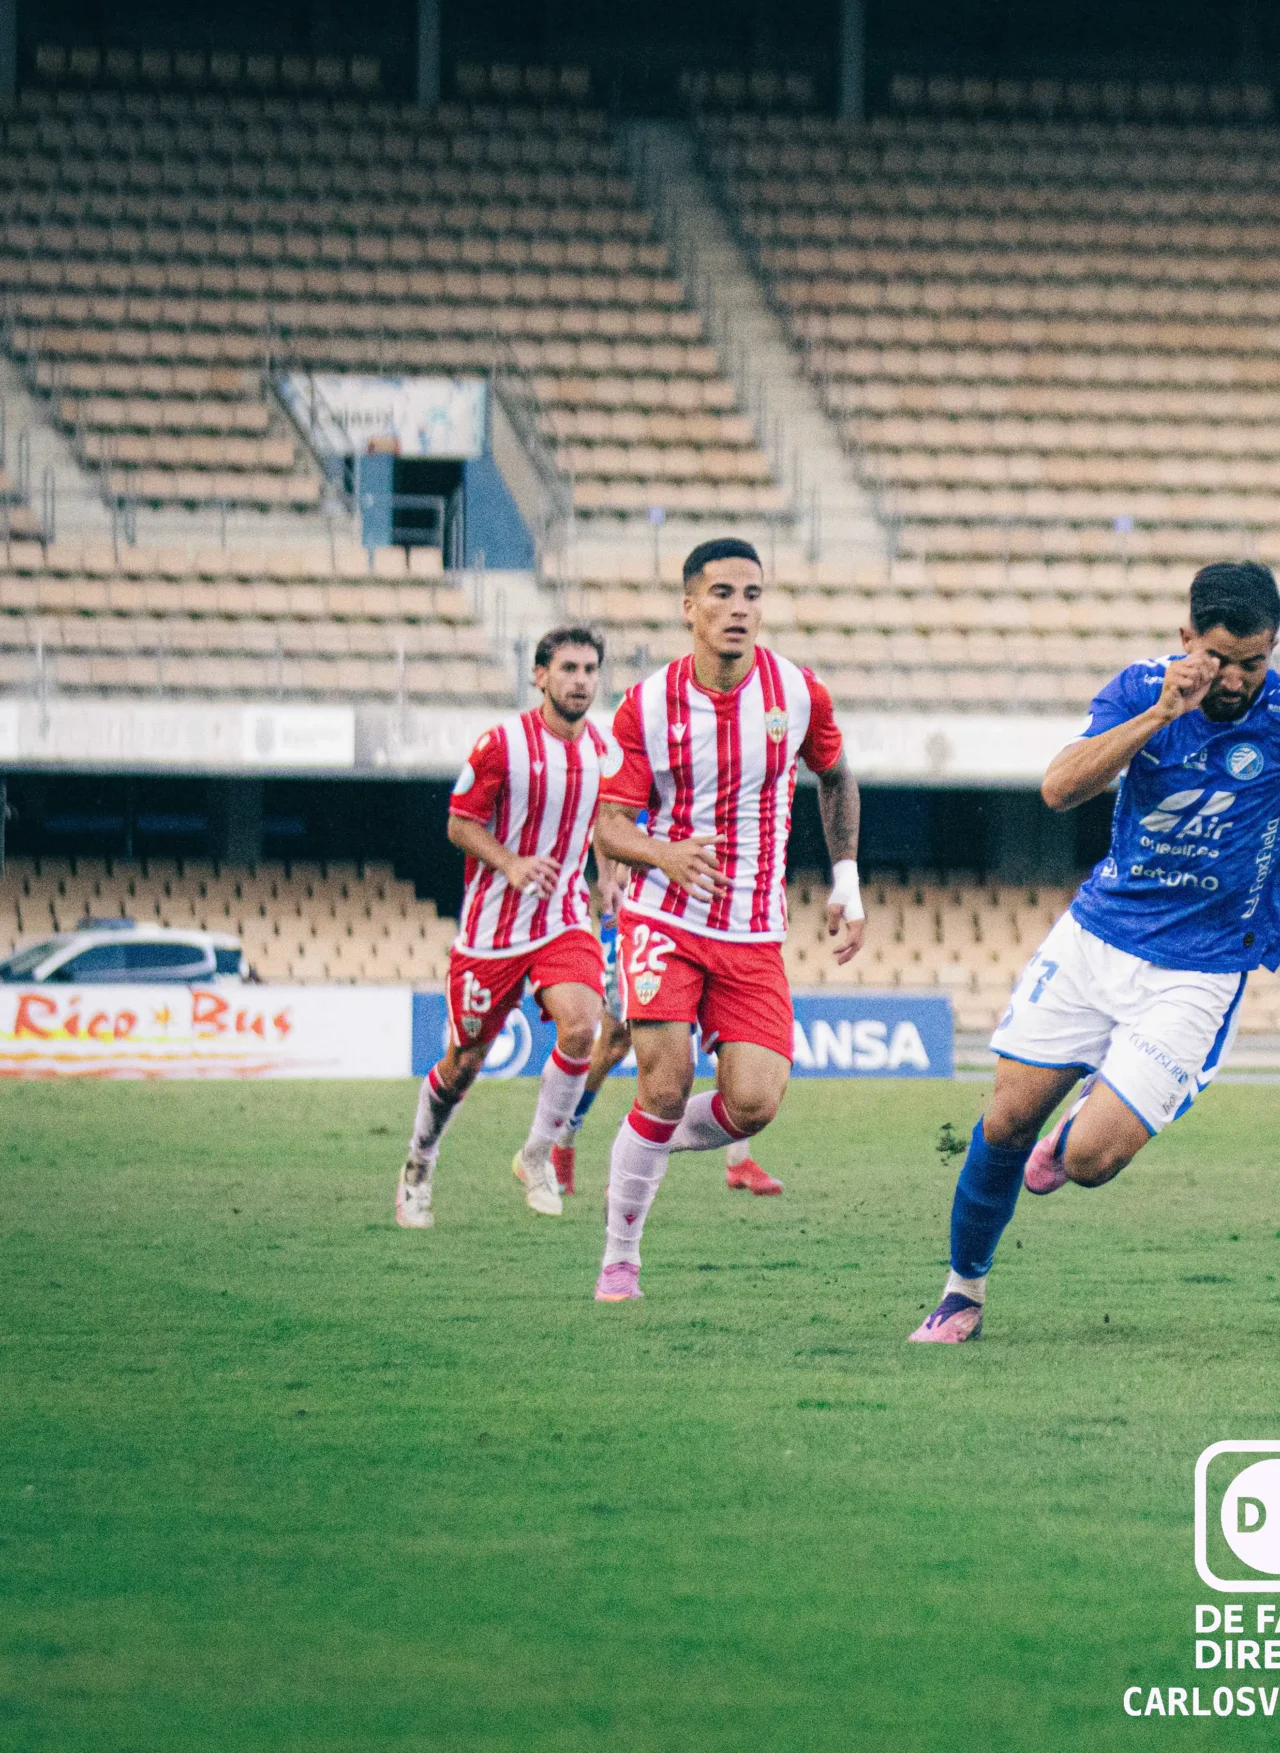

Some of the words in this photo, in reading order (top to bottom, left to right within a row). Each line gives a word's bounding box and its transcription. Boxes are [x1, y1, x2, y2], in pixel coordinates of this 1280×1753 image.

[1176, 816, 1234, 840] Air
[629, 924, 677, 973] 22
[191, 988, 292, 1038] Bus
